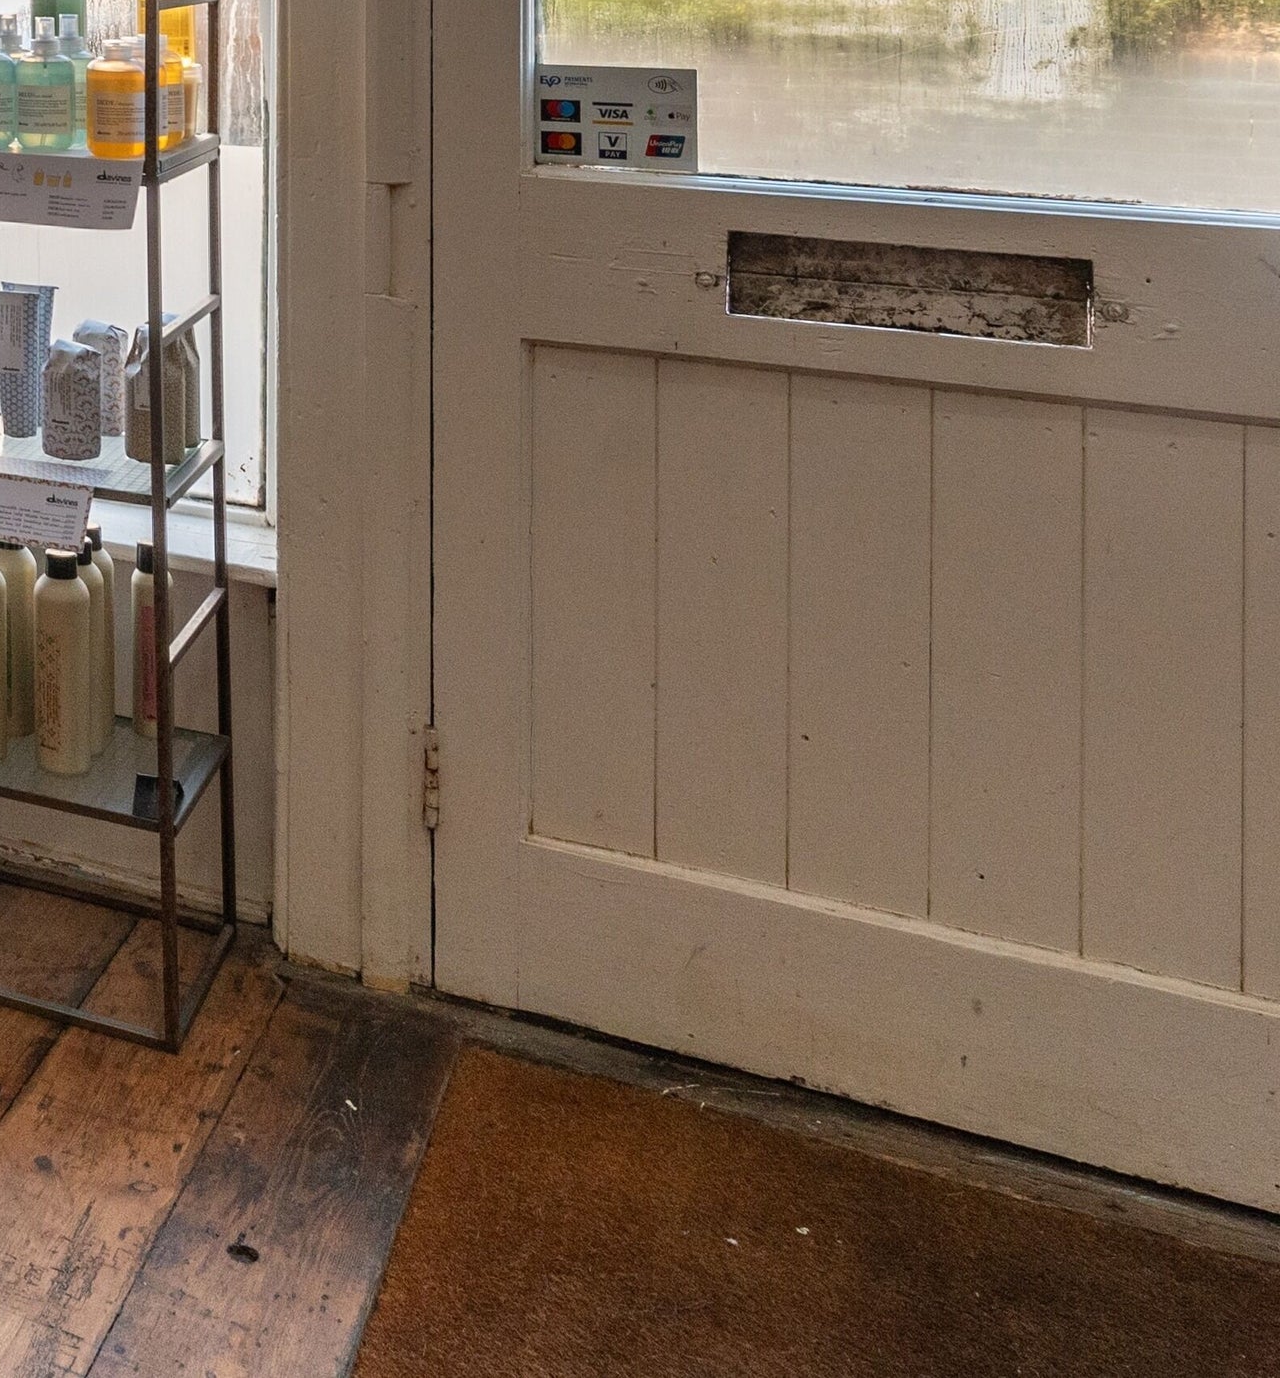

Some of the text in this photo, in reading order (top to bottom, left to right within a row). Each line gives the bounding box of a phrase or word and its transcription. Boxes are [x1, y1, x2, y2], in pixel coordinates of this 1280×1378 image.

[540, 75, 561, 88] EVO
[598, 108, 629, 120] VISA
[676, 112, 691, 121] Pay
[605, 135, 620, 147] V
[649, 139, 684, 149] UnionPay
[96, 170, 132, 182] davines
[46, 494, 79, 506] davines
